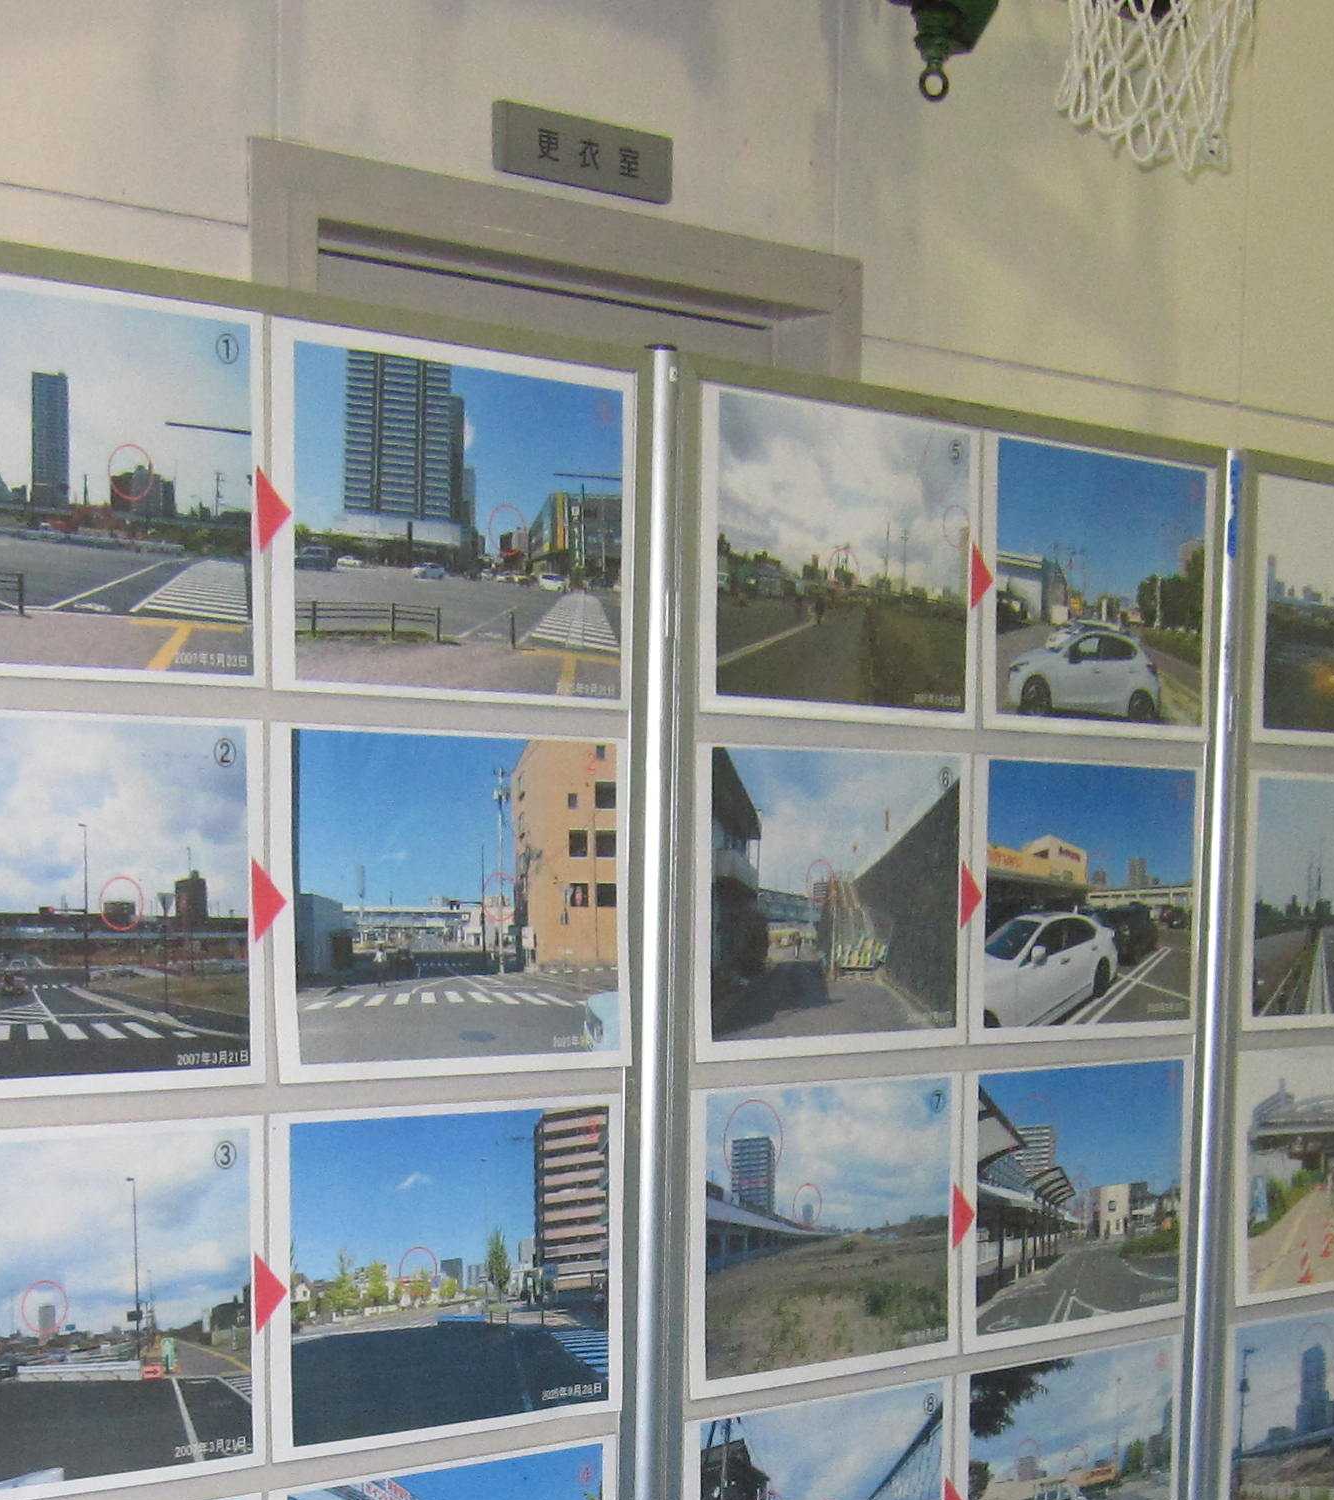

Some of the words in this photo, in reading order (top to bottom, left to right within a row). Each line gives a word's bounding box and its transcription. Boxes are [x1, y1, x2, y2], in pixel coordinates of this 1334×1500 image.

[537, 128, 640, 179] 更衣室
[177, 1050, 249, 1066] 2007年3月21日
